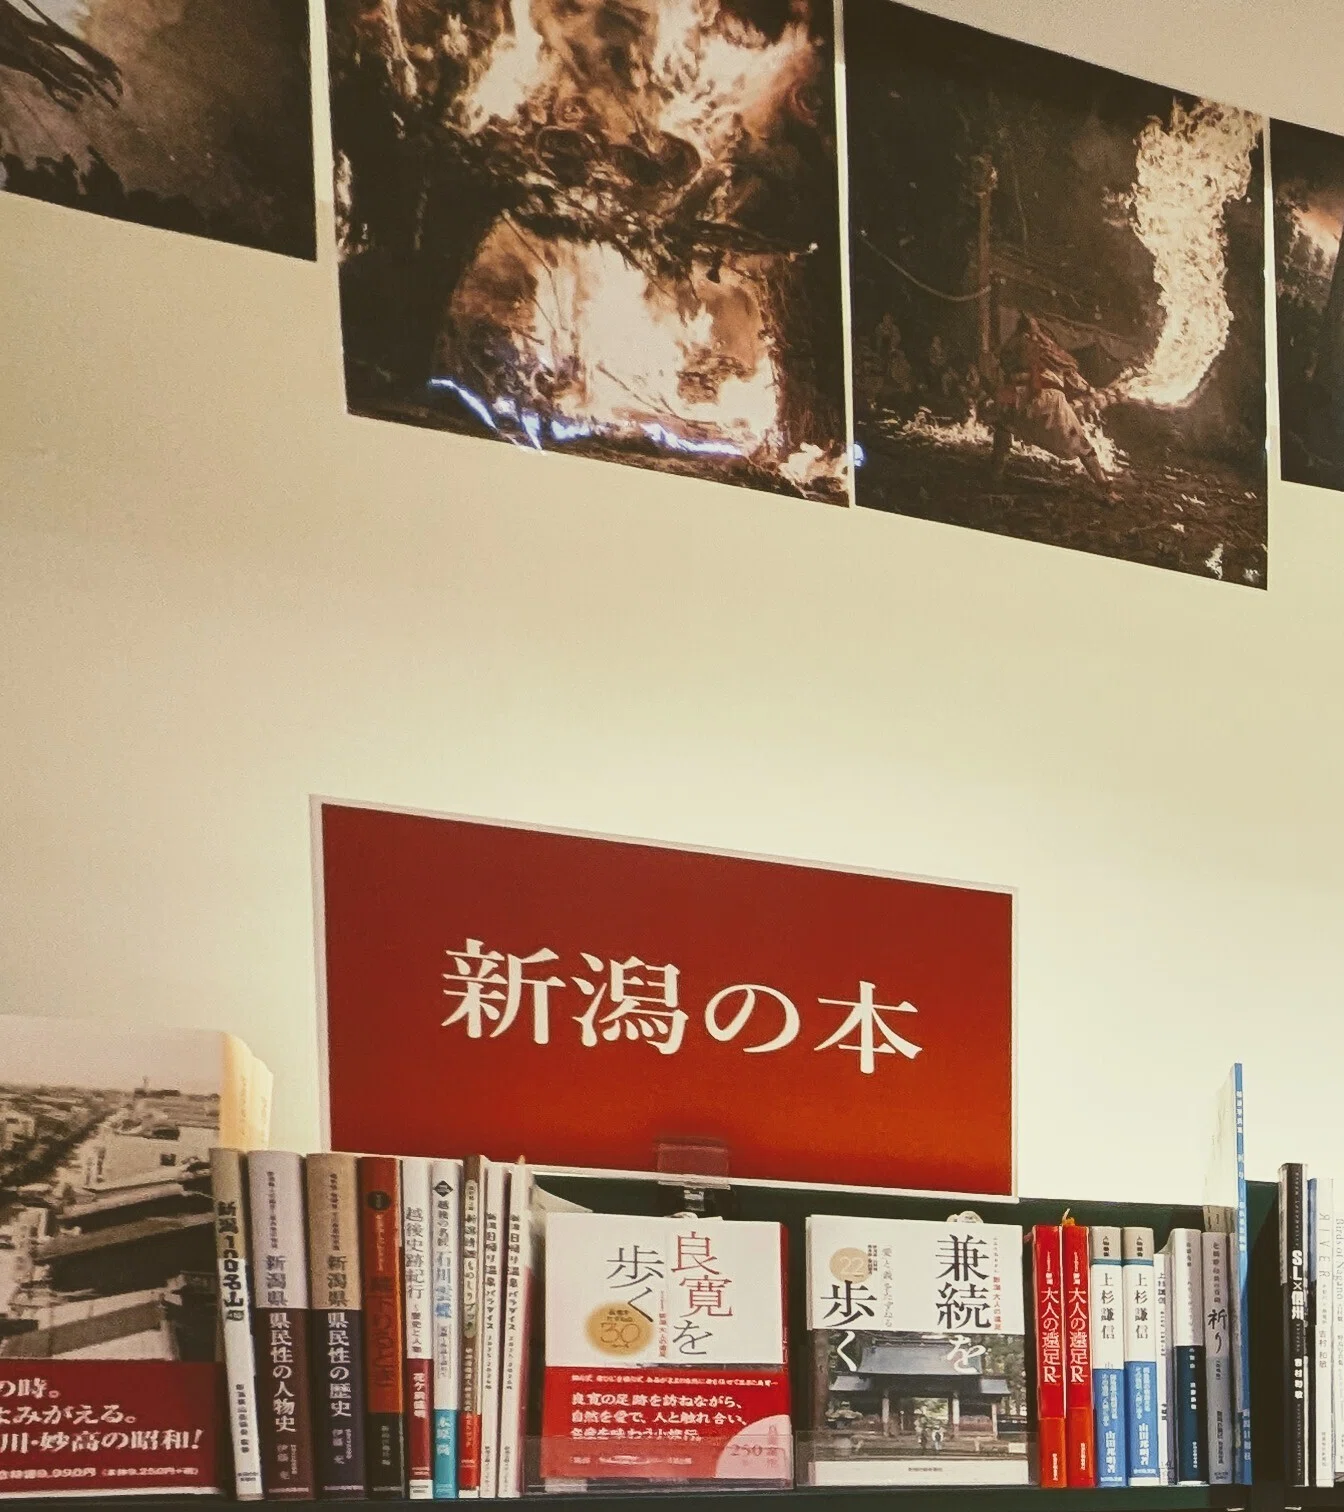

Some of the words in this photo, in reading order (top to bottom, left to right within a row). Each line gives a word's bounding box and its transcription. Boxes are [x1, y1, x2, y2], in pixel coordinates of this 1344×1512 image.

[441, 937, 923, 1075] 新潟の本
[266, 1255, 287, 1308] 新潟県
[327, 1255, 348, 1308] 新潟県
[405, 1206, 424, 1299] 越後史跡紀行
[605, 1245, 665, 1323] 歩く
[1318, 1213, 1330, 1278] RIVER
[671, 1231, 733, 1356] 良寛を
[820, 1282, 877, 1372] 歩く
[935, 1234, 990, 1374] 兼続を
[1101, 1272, 1116, 1340] 上杉謙信
[1134, 1272, 1148, 1340] 上杉謙信
[1207, 1308, 1227, 1354] 祈り
[270, 1312, 296, 1433] 県民性の人物史
[328, 1312, 352, 1418] 県民性の歴史
